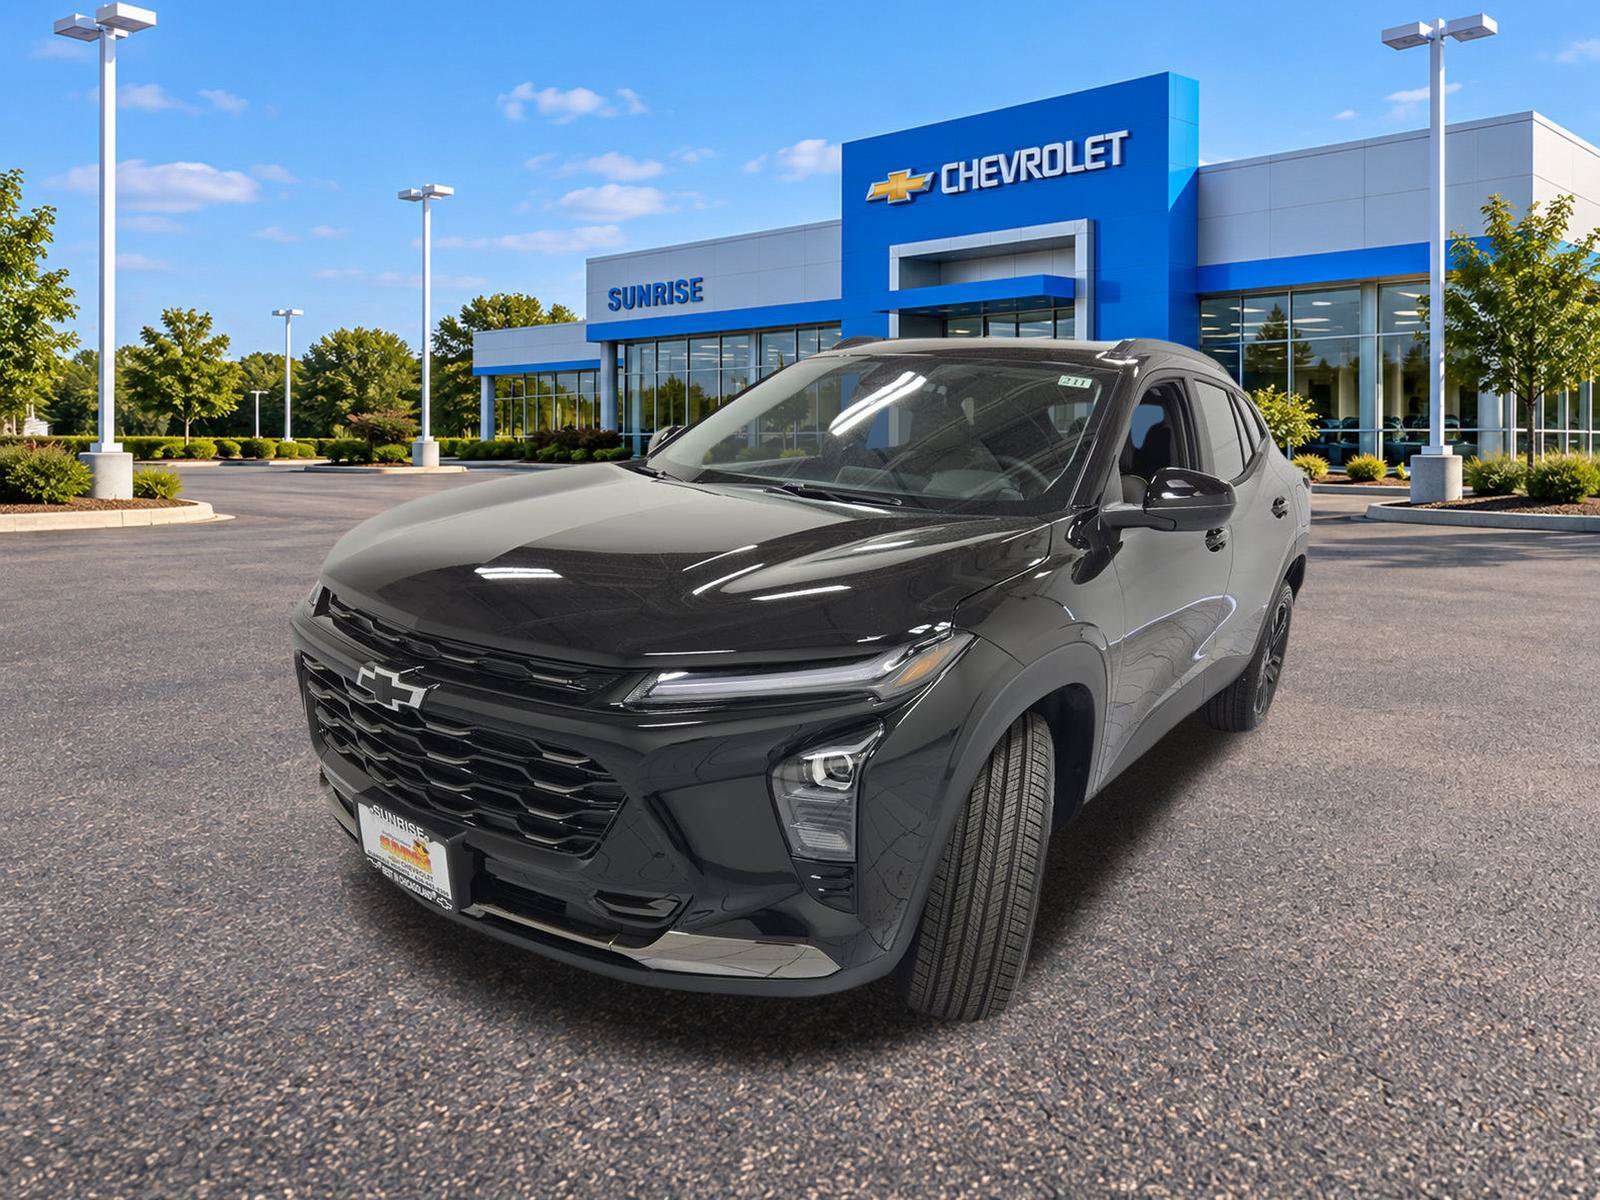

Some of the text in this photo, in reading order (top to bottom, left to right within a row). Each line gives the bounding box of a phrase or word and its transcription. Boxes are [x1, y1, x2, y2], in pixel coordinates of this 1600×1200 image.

[941, 130, 1129, 195] CHEVROLET
[607, 277, 704, 312] SUNRISE
[373, 804, 425, 838] SUNRISE
